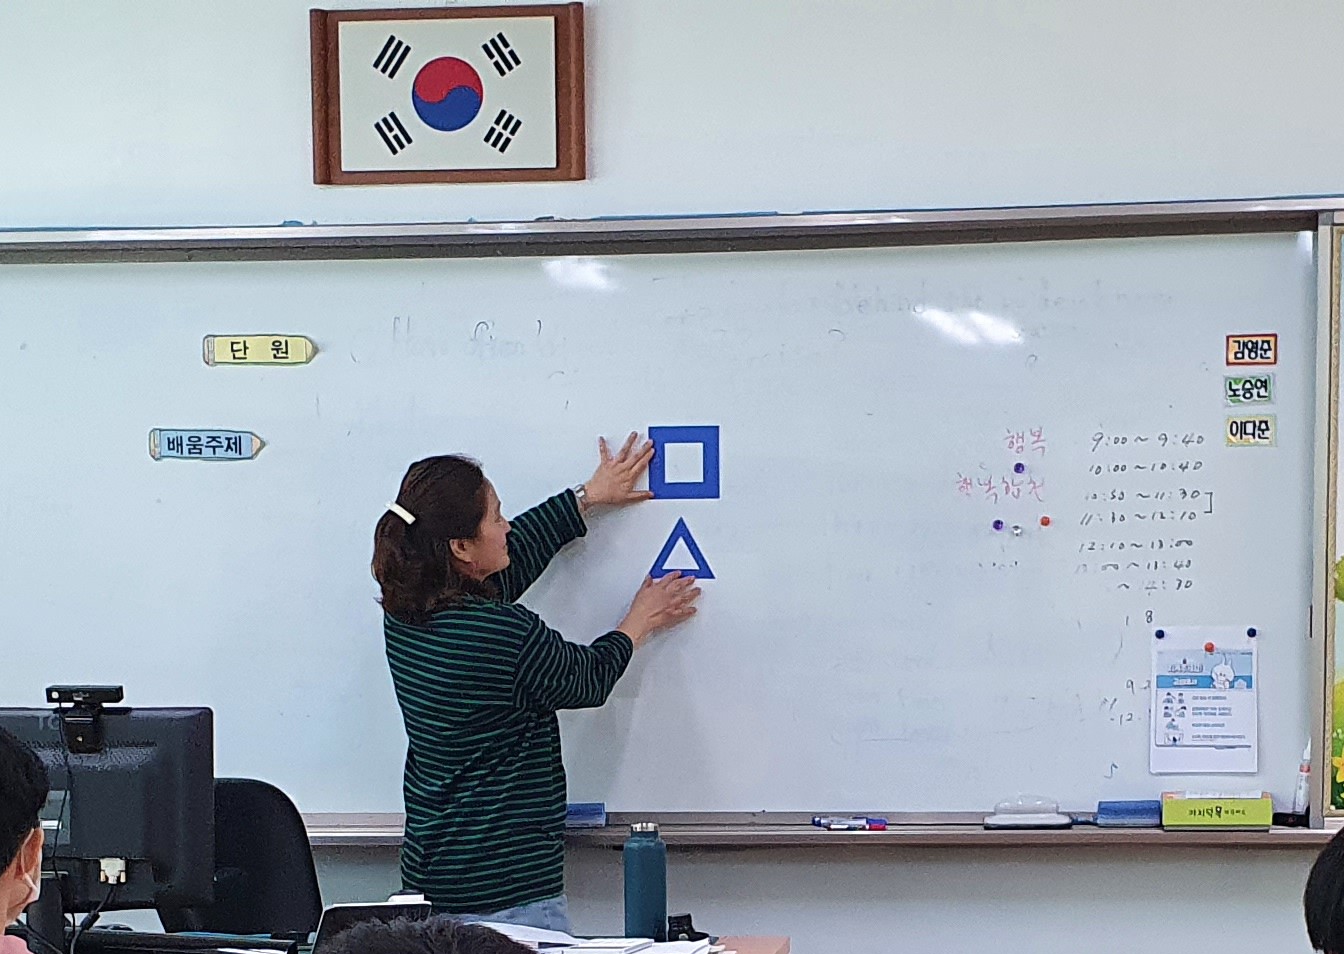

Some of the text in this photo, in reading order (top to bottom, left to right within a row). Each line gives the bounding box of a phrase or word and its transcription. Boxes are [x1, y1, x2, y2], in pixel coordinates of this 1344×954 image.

[1232, 339, 1272, 360] 김영준
[1228, 378, 1268, 400] 노승연
[167, 435, 242, 456] 배움주제
